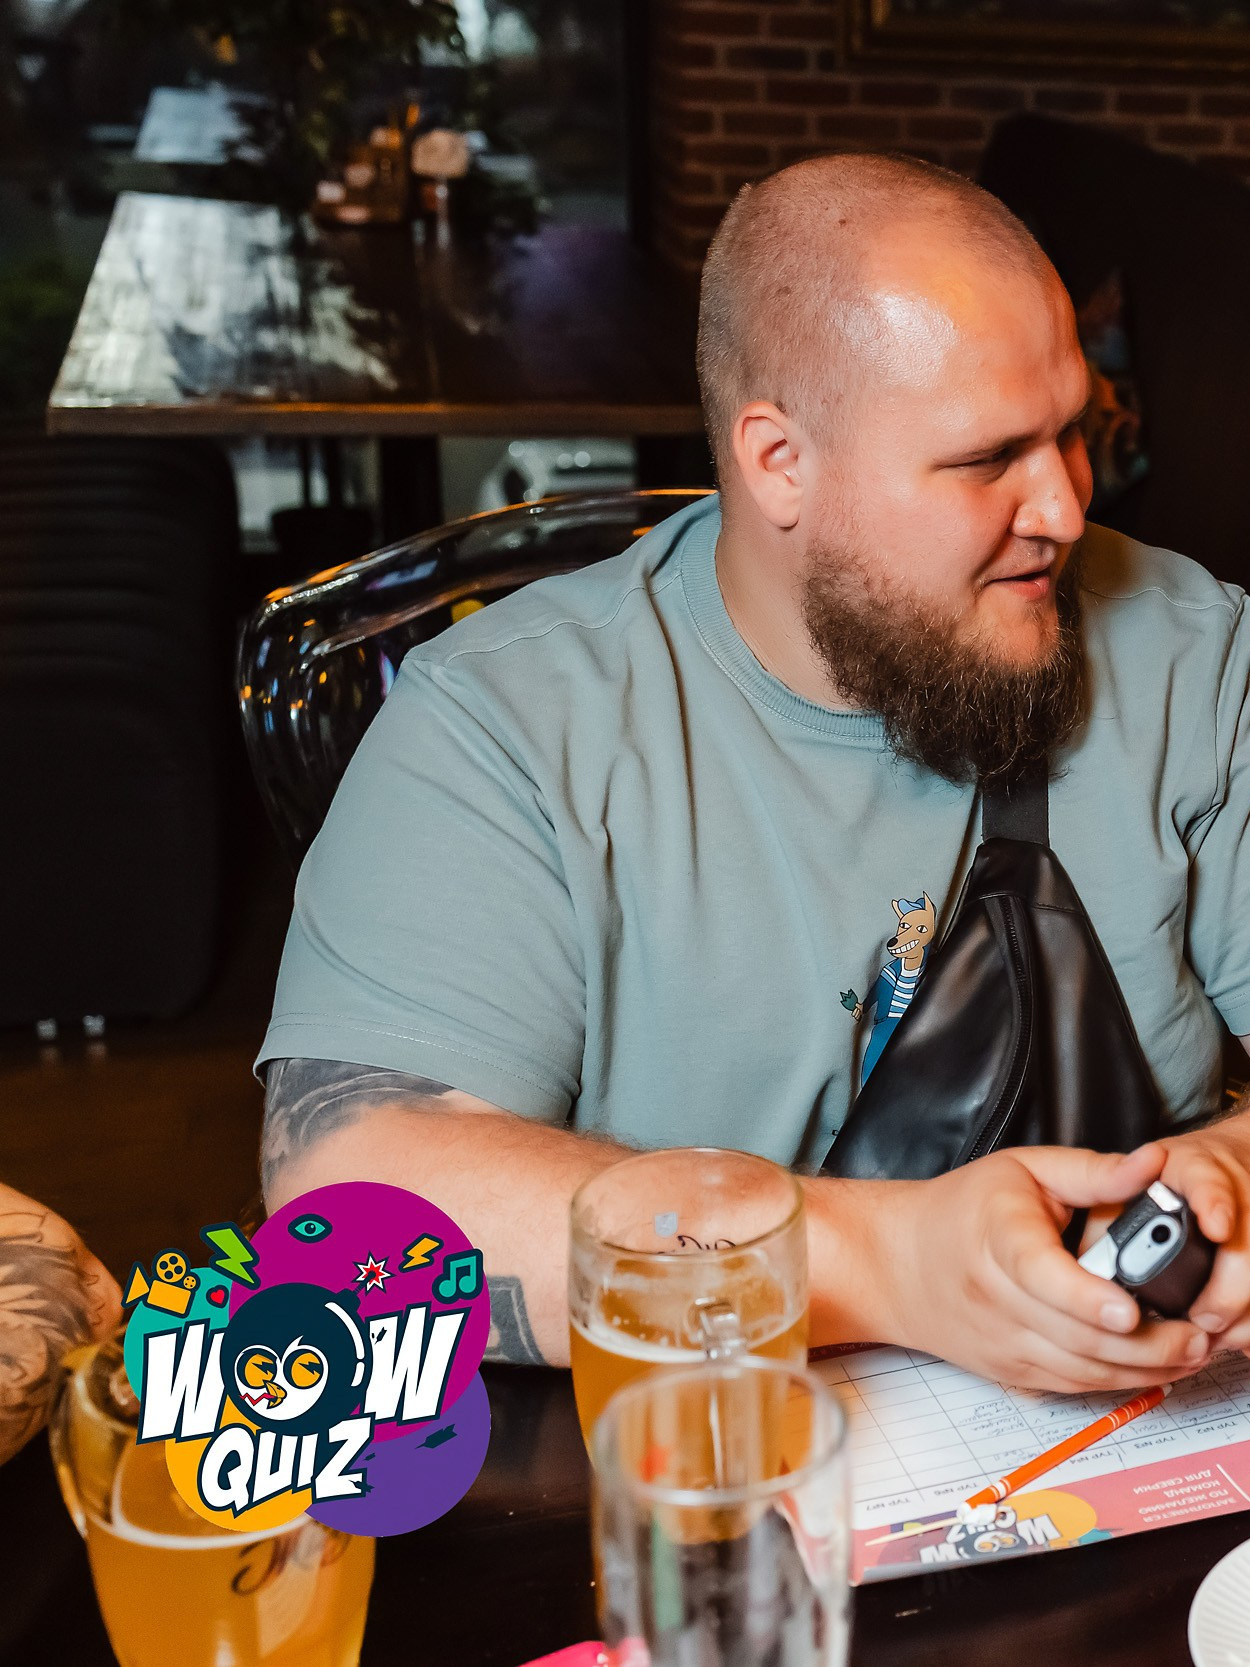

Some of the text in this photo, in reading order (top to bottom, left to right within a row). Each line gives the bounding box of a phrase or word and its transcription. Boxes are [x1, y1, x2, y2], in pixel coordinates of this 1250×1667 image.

[1132, 1469, 1211, 1495] ДЛЯ СВЕРКИ
[1163, 1480, 1220, 1498] КОМАНД
[1138, 1488, 1228, 1515] ПО ЖЕЛАНИЮ
[1142, 1497, 1236, 1523] ЗАПОЛНЯЕТСЯ
